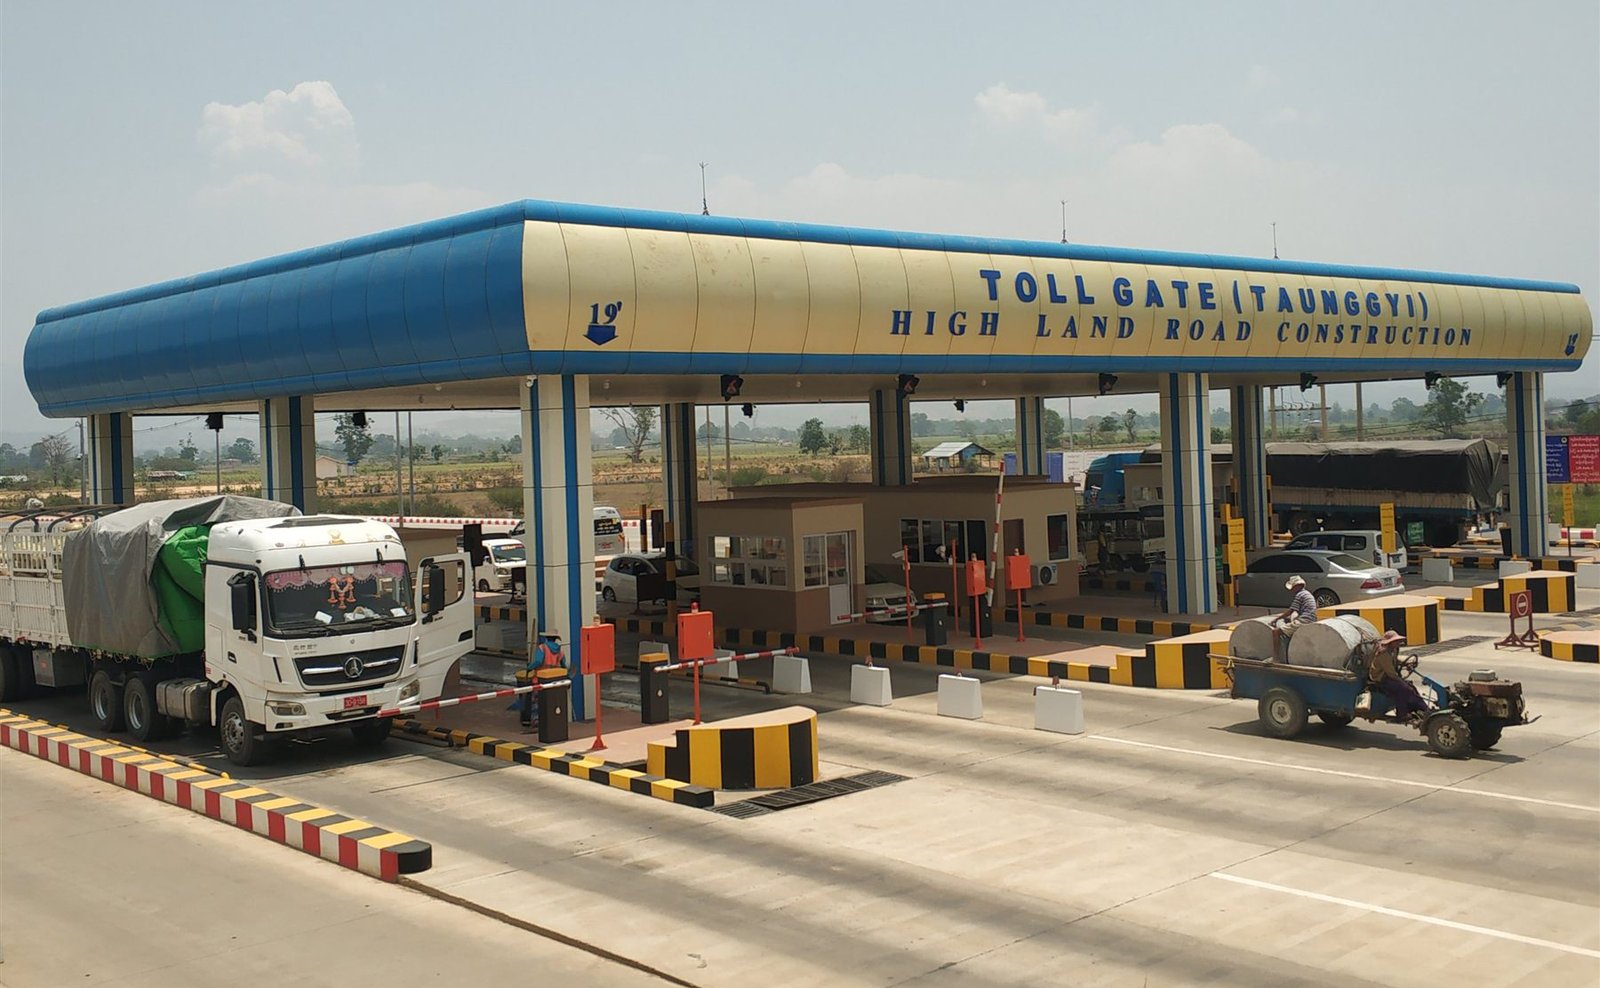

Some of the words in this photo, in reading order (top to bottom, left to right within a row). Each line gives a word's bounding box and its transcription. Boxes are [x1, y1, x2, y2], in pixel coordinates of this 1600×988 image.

[979, 269, 1096, 305] TOLL
[1112, 276, 1217, 310] GATE
[1232, 279, 1429, 321] (TAUNGGYI)
[889, 309, 1000, 336] HIGH
[1035, 313, 1136, 339] LAND
[1164, 318, 1252, 342] ROAD
[1276, 320, 1473, 347] CONSTRUCTION
